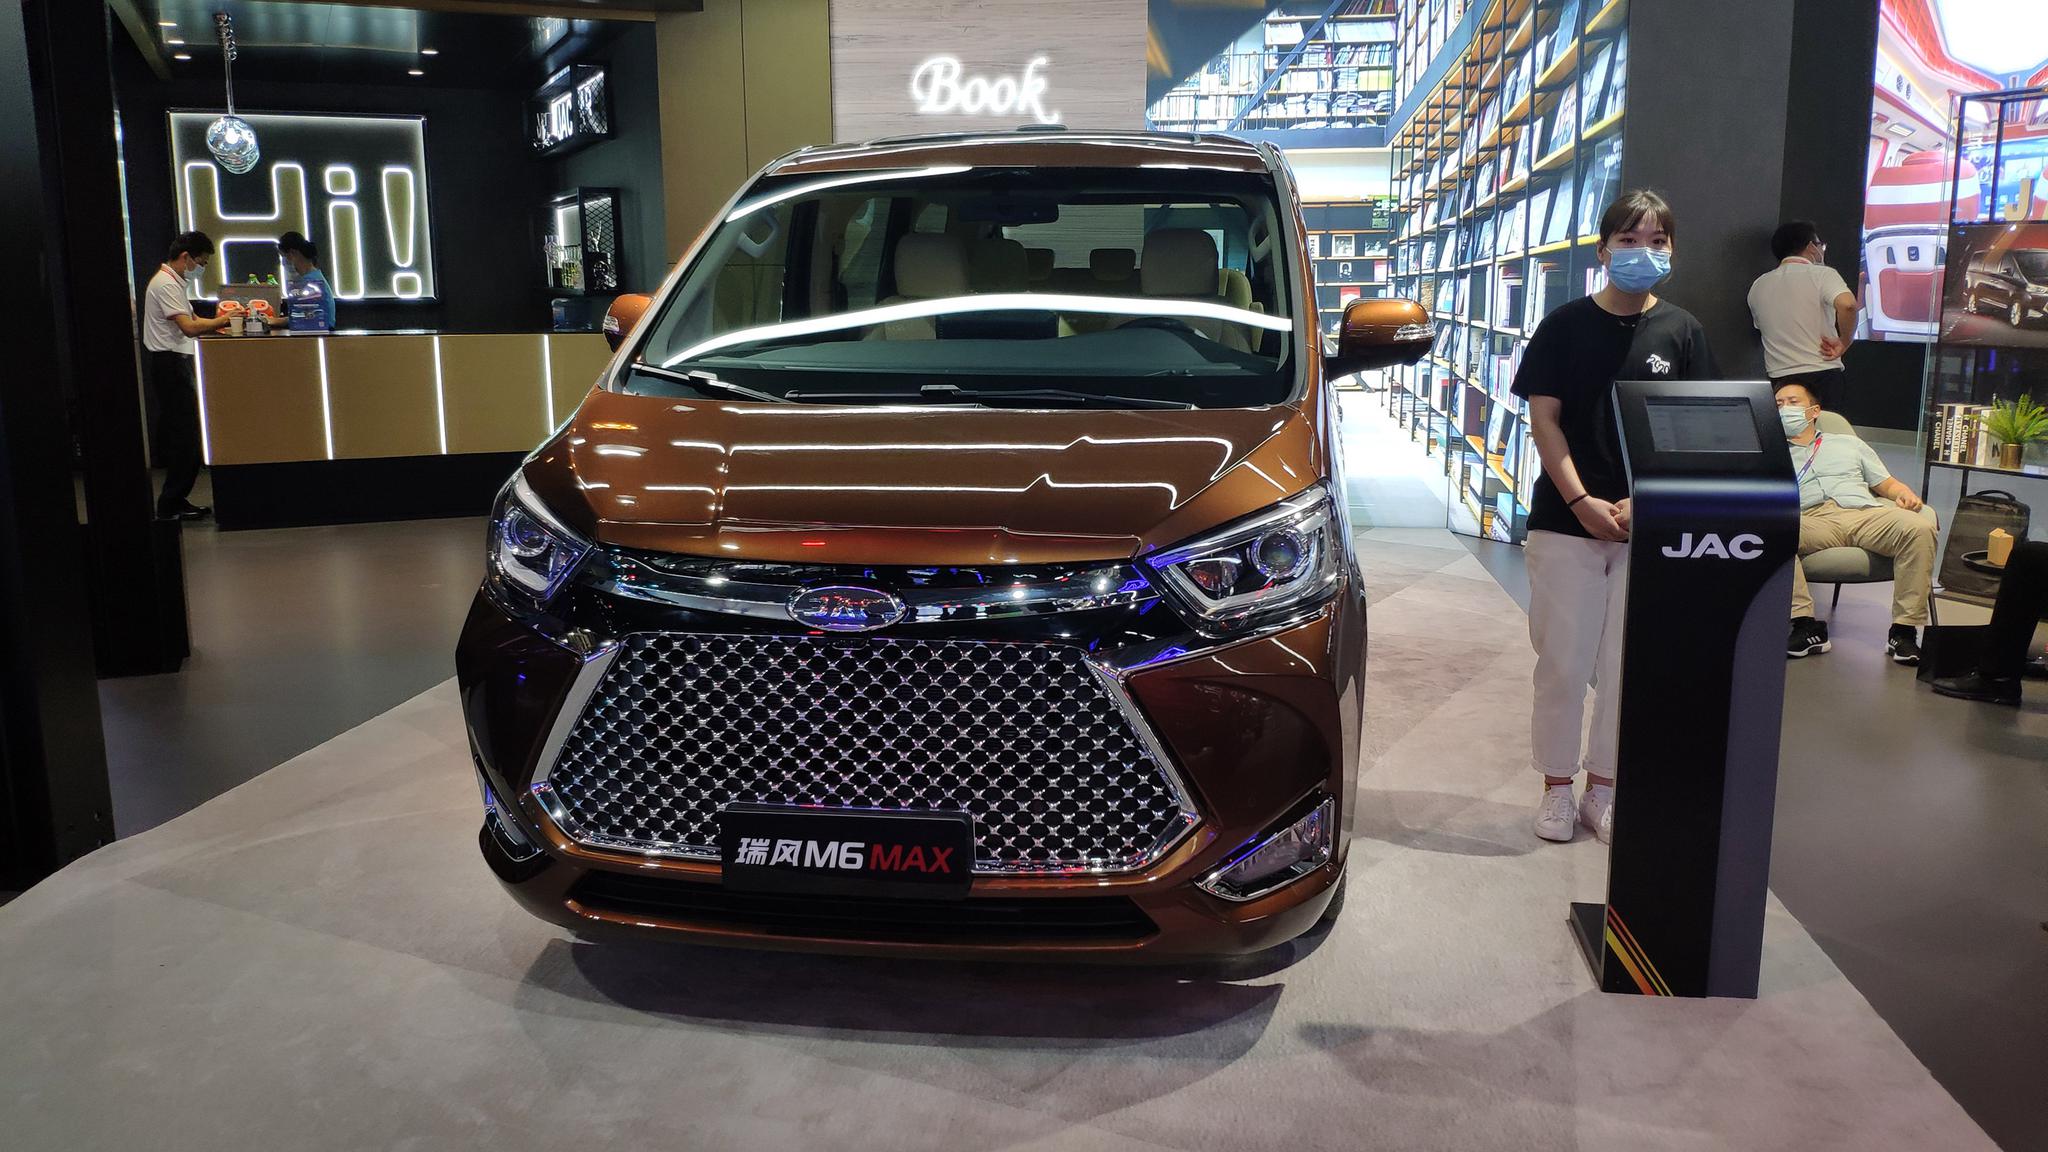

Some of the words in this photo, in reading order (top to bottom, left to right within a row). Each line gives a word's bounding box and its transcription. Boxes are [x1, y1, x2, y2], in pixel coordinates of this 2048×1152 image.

[912, 56, 1060, 124] Book
[184, 162, 423, 300] Hi!
[1933, 422, 1941, 450] CHANEL
[1945, 417, 1953, 445] CHANEL
[1960, 425, 1968, 453] CHANEL
[1661, 532, 1764, 560] JAC
[735, 837, 865, 870] 瑞风M6
[869, 843, 953, 873] MAX
